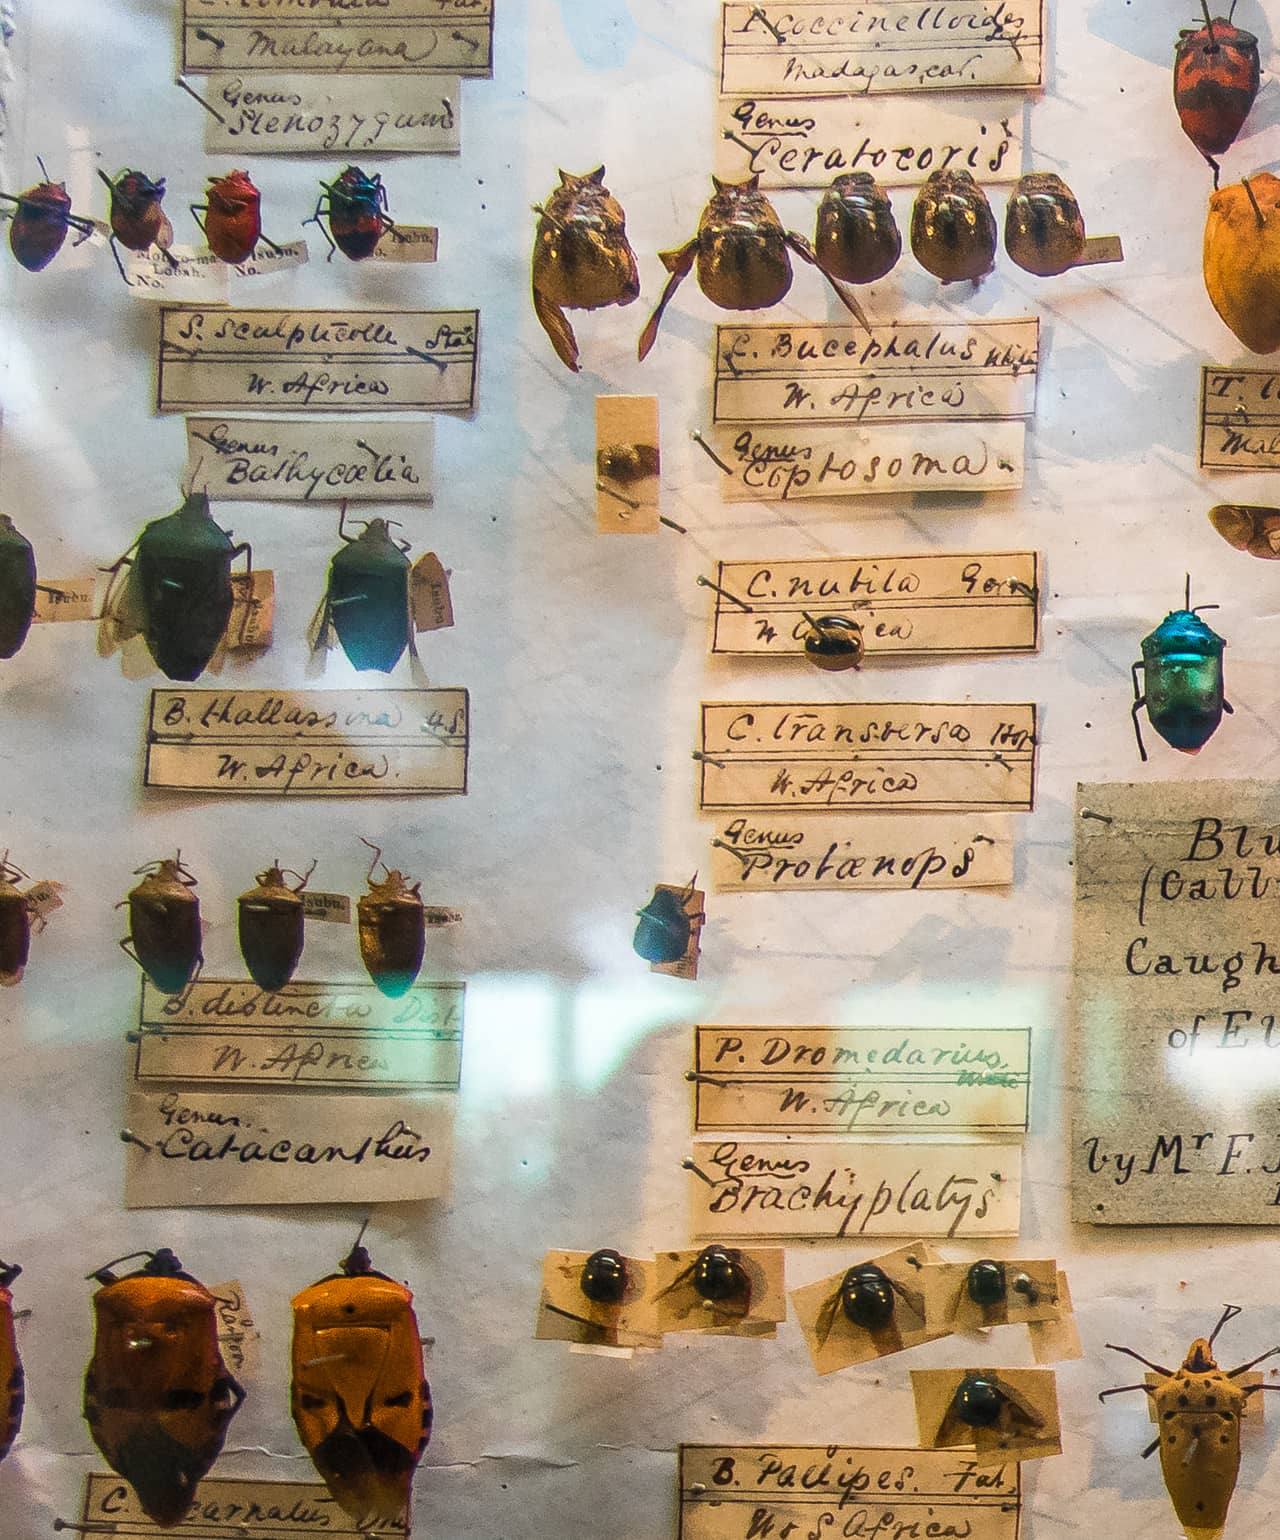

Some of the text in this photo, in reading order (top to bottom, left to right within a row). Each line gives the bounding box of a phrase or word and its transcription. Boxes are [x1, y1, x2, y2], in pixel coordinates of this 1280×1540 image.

[223, 80, 301, 107] Genus
[731, 101, 817, 130] Genus
[750, 127, 1010, 174] Ceratocoris
[283, 371, 389, 404] Africa
[831, 381, 965, 420] Africa
[209, 423, 278, 455] Genus
[734, 431, 813, 462] Genus
[743, 441, 988, 499] Coptosoma
[748, 566, 919, 598] C. nubila
[164, 698, 191, 727] B.
[727, 714, 761, 743] C.
[218, 753, 248, 780] W.
[801, 768, 918, 807] Africa
[724, 819, 804, 848] Genus
[1167, 1013, 1202, 1056] of
[824, 1088, 951, 1131] Africa
[159, 1121, 431, 1164] Catacanthus
[1083, 1138, 1137, 1185] by
[1141, 1132, 1213, 1175] Mr
[1217, 1134, 1254, 1176] F.
[709, 1142, 810, 1177] Genus
[709, 1169, 995, 1237] Brachyplatys
[185, 1502, 331, 1526] carnatus
